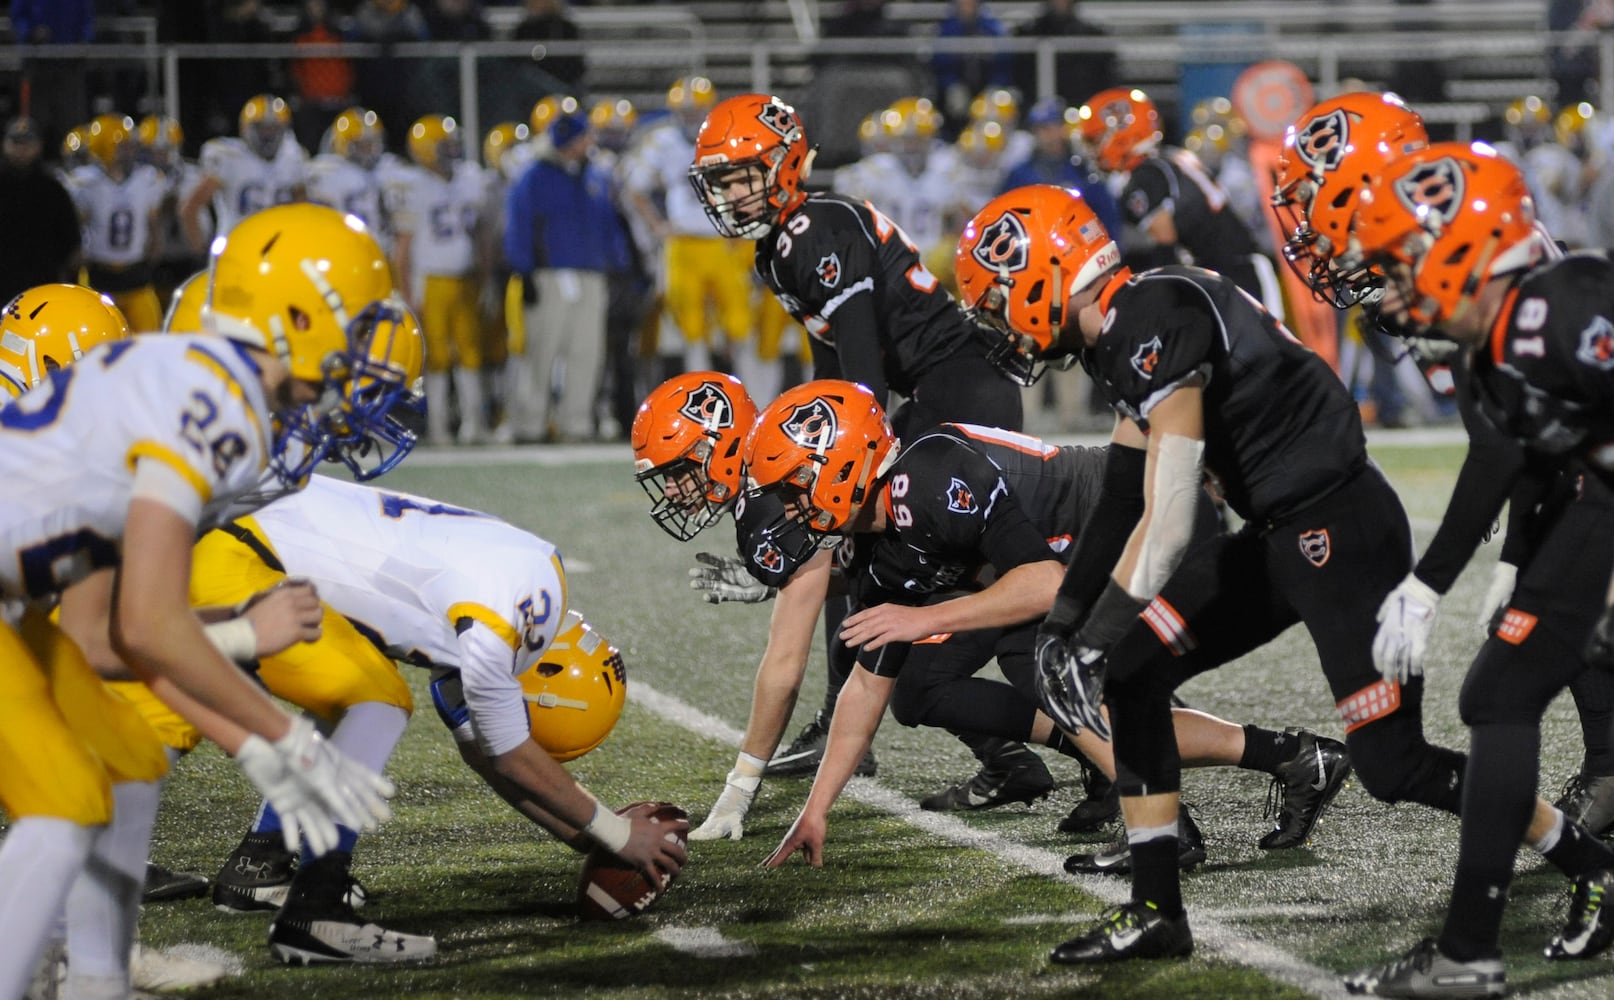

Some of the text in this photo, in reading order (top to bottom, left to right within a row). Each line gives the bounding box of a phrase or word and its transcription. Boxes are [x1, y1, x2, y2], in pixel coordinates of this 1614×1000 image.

[110, 208, 133, 249] 8
[777, 211, 811, 258] 35
[179, 391, 248, 480] 28
[891, 474, 913, 527] 68
